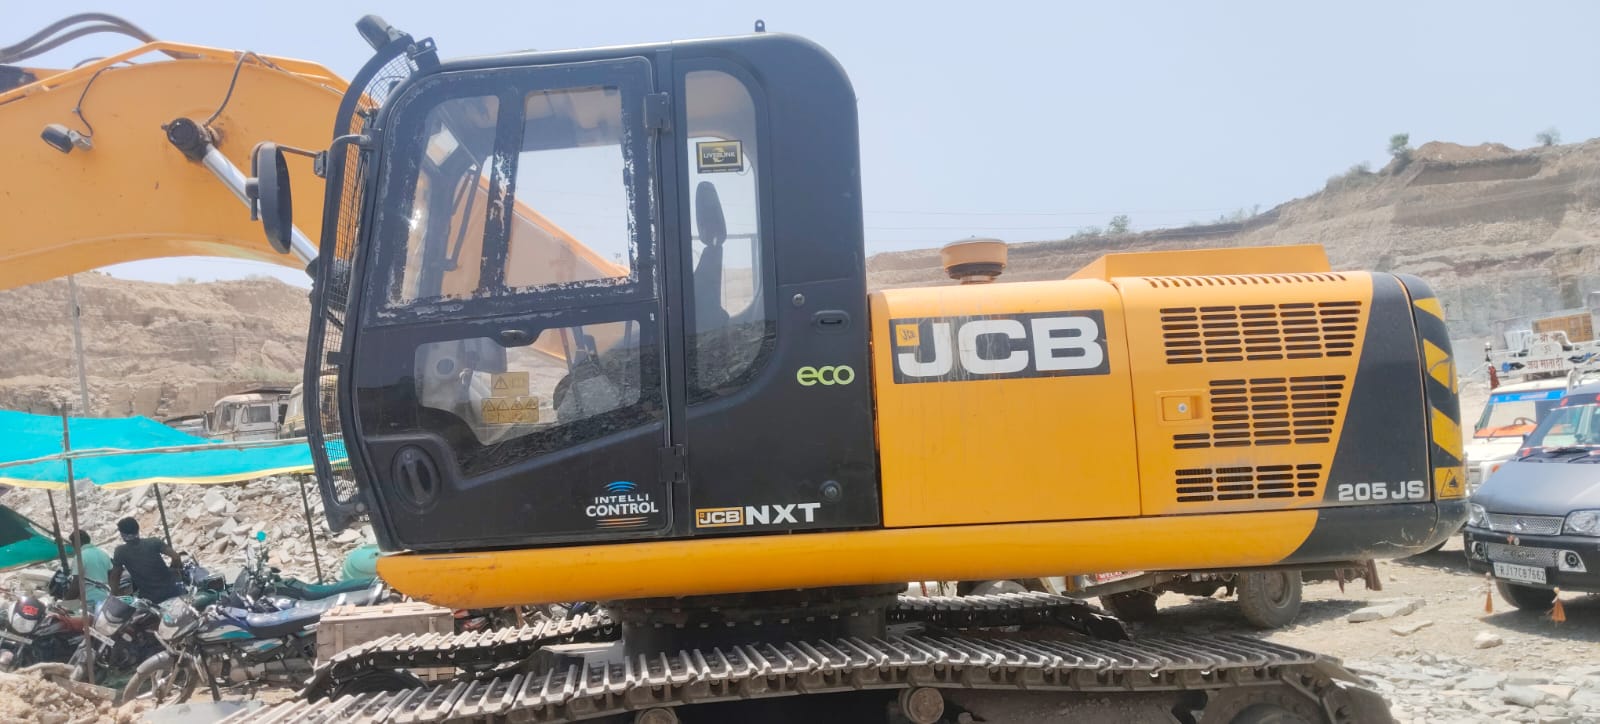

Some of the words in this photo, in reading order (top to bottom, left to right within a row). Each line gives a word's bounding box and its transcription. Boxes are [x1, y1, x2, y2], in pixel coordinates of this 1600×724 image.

[898, 316, 1104, 377] JCB
[797, 365, 855, 387] eco
[594, 493, 649, 504] INTELLI
[1338, 482, 1387, 501] 205
[1391, 480, 1425, 500] JS
[585, 502, 659, 517] CONTROL
[699, 510, 740, 525] JCB
[745, 502, 821, 525] NXT
